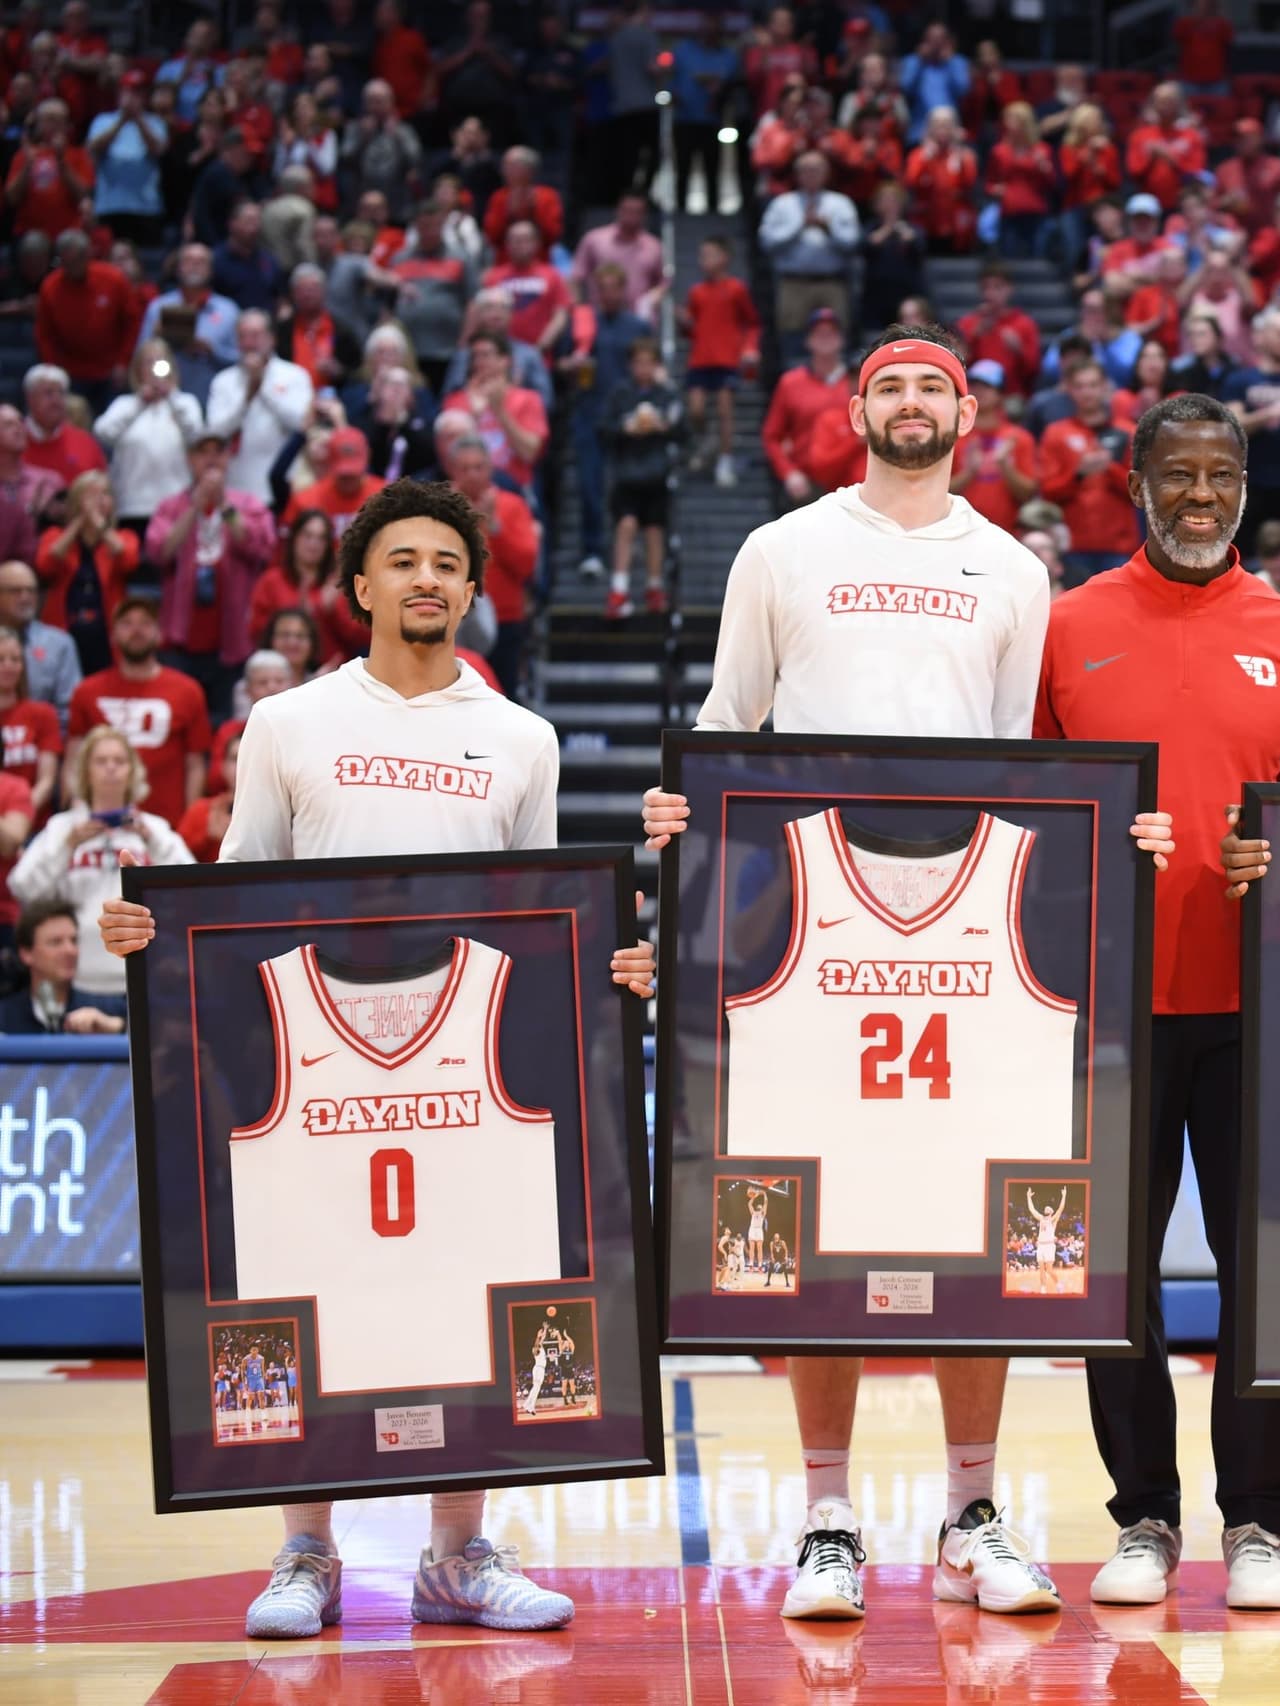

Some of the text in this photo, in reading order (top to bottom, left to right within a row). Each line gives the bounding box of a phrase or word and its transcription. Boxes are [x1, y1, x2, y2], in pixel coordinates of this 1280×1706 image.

[827, 583, 978, 623] DAYTON
[334, 755, 492, 800] DAYTON
[818, 959, 992, 996] DAYTON
[860, 1012, 951, 1099] 24
[0, 1086, 86, 1176] th
[302, 1090, 481, 1136] DAYTON
[0, 1171, 85, 1235] nt
[369, 1148, 416, 1237] 0
